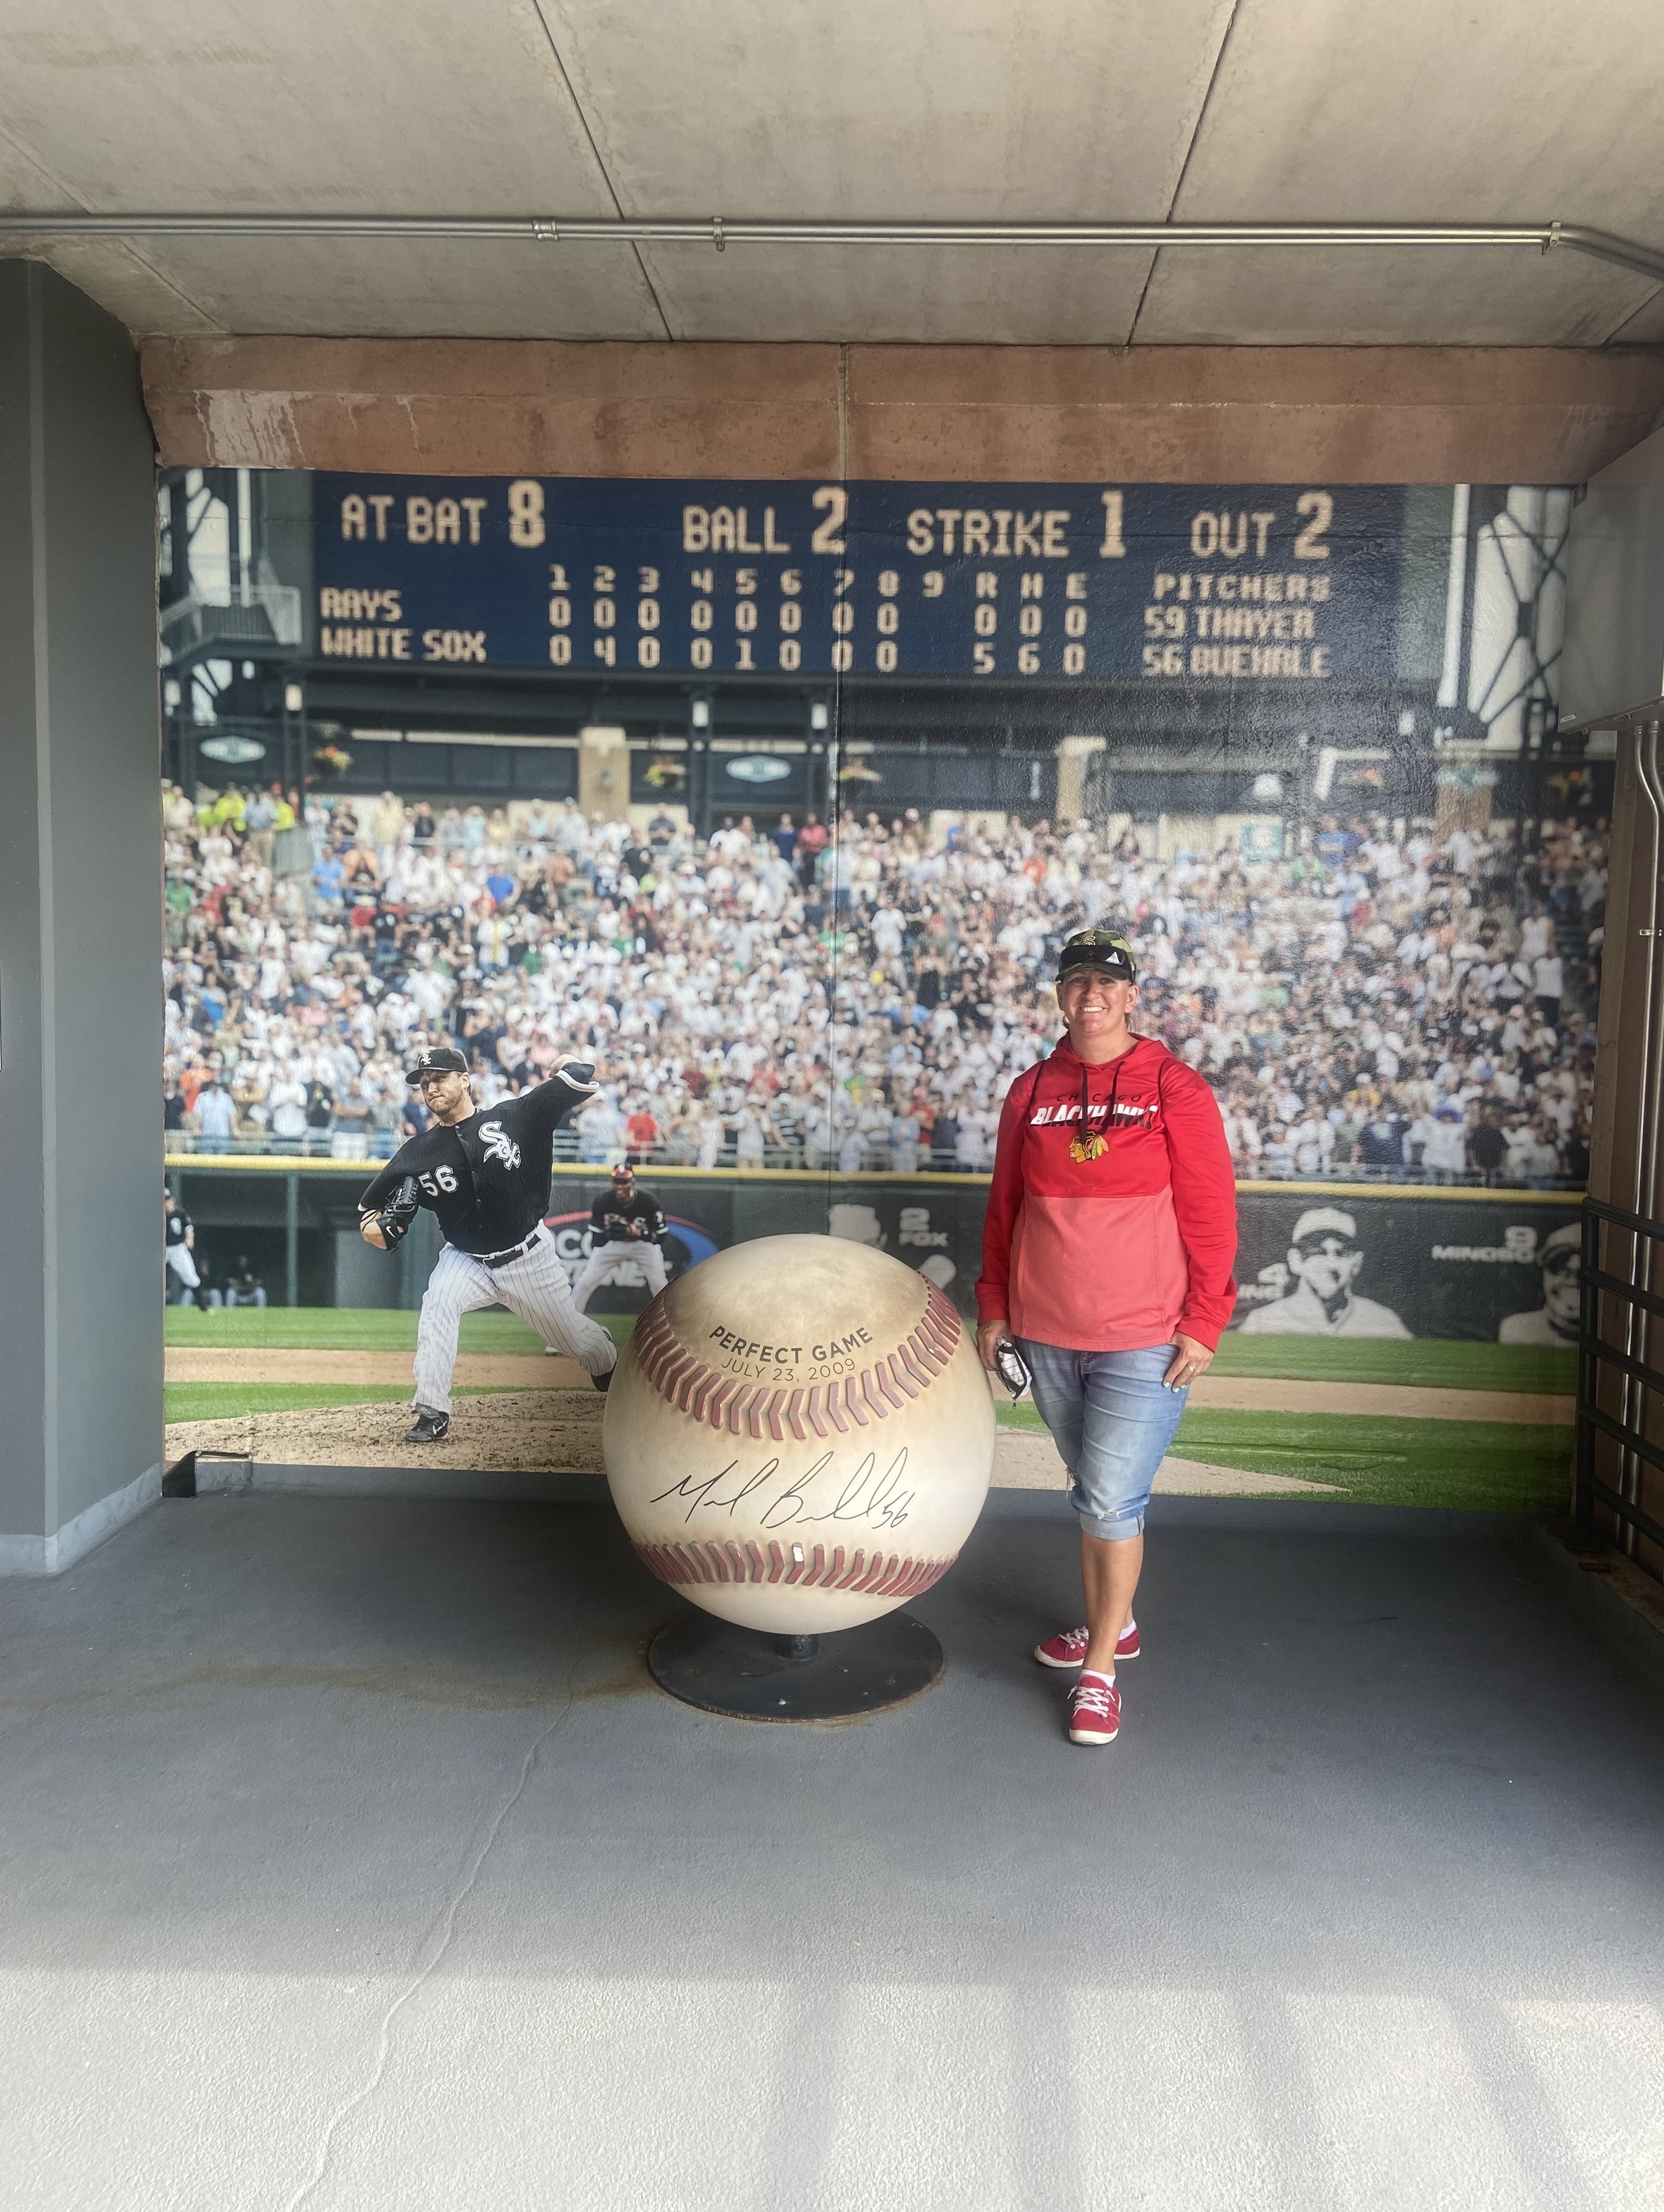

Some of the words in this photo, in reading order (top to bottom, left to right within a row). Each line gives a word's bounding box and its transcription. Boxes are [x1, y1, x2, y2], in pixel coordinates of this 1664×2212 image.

[342, 495, 394, 540] AT
[407, 497, 486, 544] BAT
[508, 480, 545, 547] 8
[683, 506, 790, 553] BALL
[812, 486, 848, 555] 2
[907, 509, 1070, 557] STRIKE
[1101, 490, 1126, 558] 1
[1191, 511, 1276, 558] OUT
[1294, 491, 1333, 559] 2
[550, 564, 569, 590] 1
[594, 566, 615, 591] 2
[639, 567, 659, 592] 3
[691, 569, 713, 593] 4
[736, 569, 756, 594] 5
[780, 569, 801, 594] 6
[924, 571, 944, 597] 9
[1021, 573, 1043, 599] H
[1066, 573, 1086, 599] E
[1154, 573, 1330, 601] PITCHERS
[321, 588, 402, 622] RAYS
[549, 597, 571, 627] 0
[594, 597, 615, 628] 0
[638, 599, 659, 630] 0
[691, 600, 712, 631] 0
[736, 601, 757, 632] 0
[780, 602, 801, 632] 0
[833, 602, 854, 633] 0
[877, 603, 899, 634] 0
[975, 604, 997, 636] 0
[1020, 605, 1042, 636] 0
[1065, 606, 1087, 636] 0
[1145, 606, 1186, 638] 59
[321, 627, 412, 659] WHITE
[423, 629, 486, 662] SOX
[550, 635, 571, 666] 0
[594, 636, 615, 666] 4
[638, 636, 659, 668] 0
[691, 638, 712, 668] 0
[736, 639, 754, 670] 1
[780, 639, 801, 670] 0
[832, 640, 852, 671] 0
[877, 641, 898, 672] 0
[974, 643, 995, 674] 5
[1019, 644, 1040, 674] 6
[1064, 644, 1085, 675] 0
[1143, 645, 1183, 677] 56
[1057, 1093, 1141, 1102] CHCAGO
[418, 1165, 458, 1197] 56
[710, 1326, 802, 1363] PERFECT
[812, 1327, 873, 1361] GAME
[721, 1358, 765, 1379] JULY
[773, 1368, 800, 1382] 23,
[808, 1358, 855, 1380] 2009
